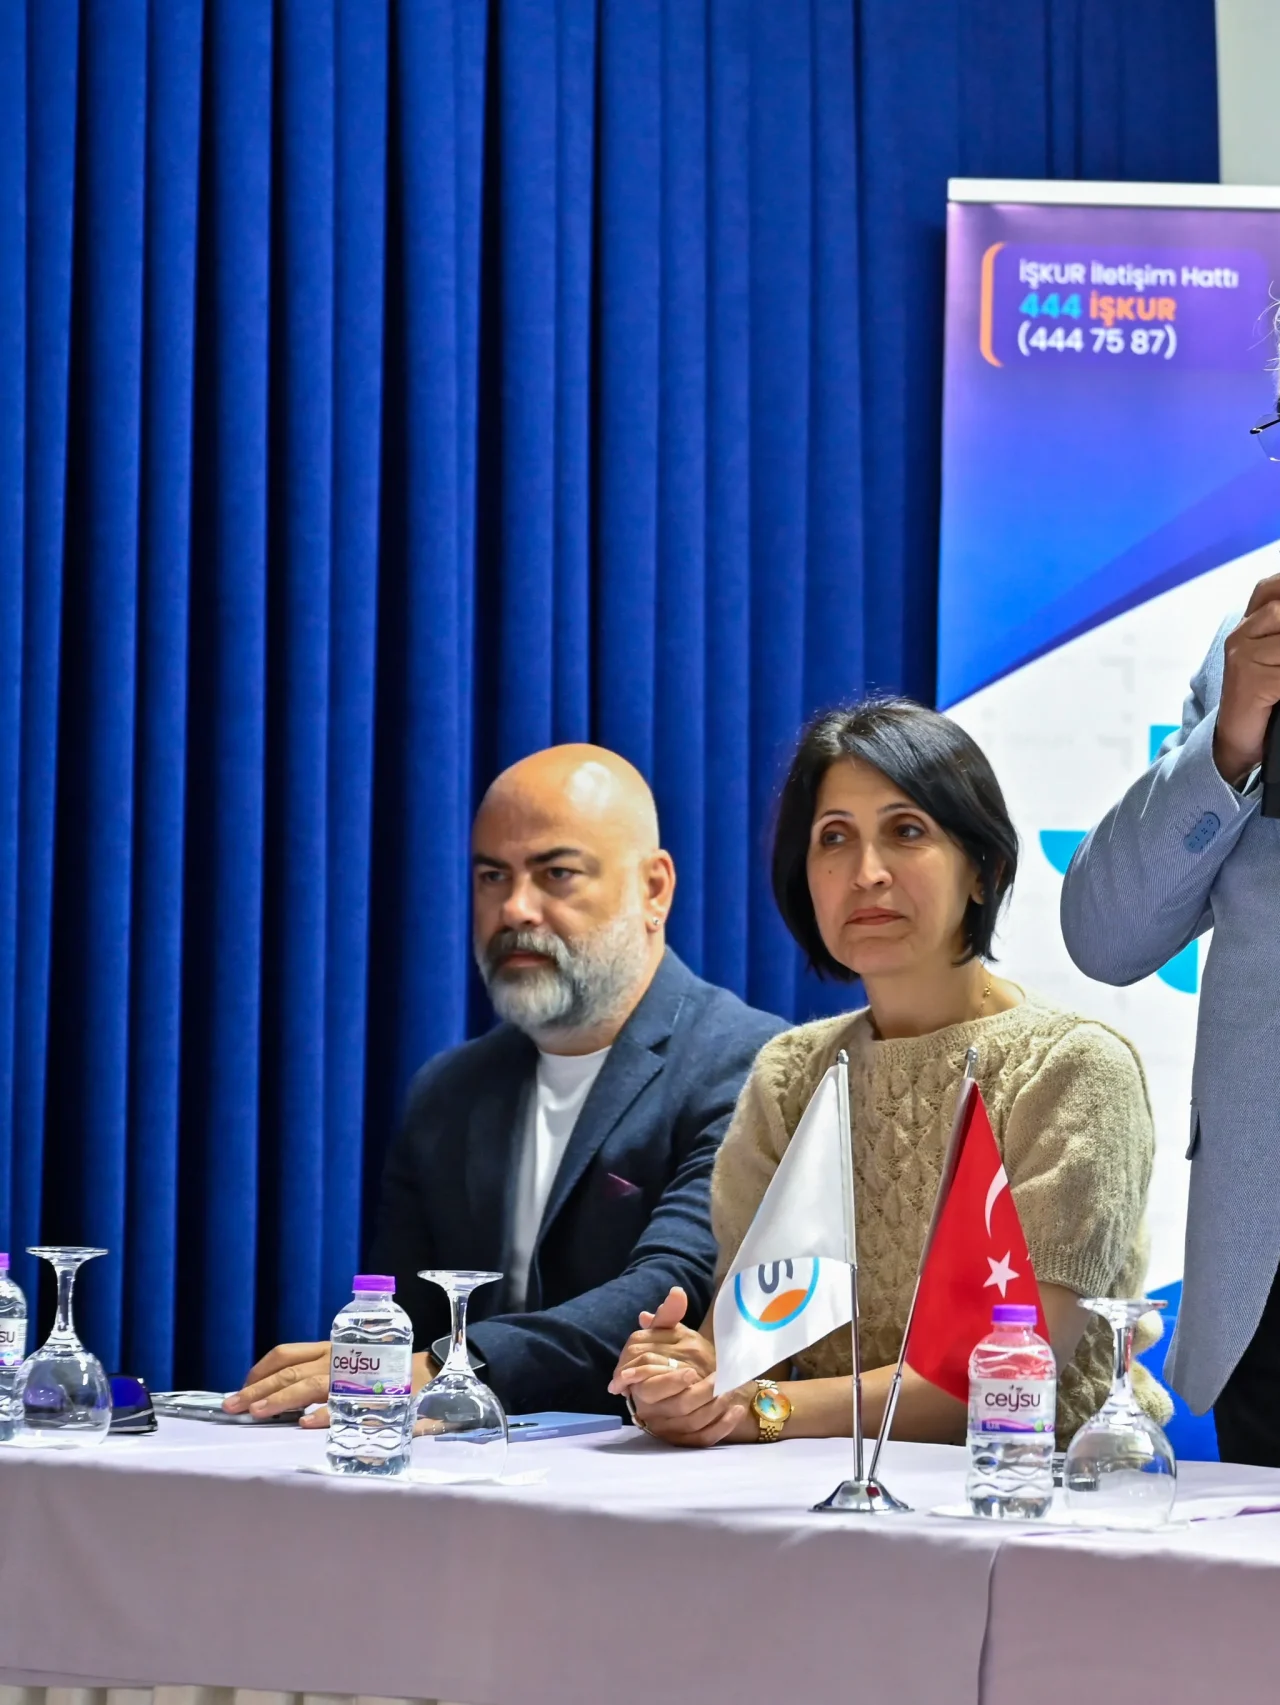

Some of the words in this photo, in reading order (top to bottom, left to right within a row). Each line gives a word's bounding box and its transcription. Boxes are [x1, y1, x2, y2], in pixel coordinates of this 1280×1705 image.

[1019, 258, 1086, 289] İŞKUR
[1090, 260, 1176, 291] İletişim
[1181, 266, 1239, 288] Hattı
[1019, 292, 1082, 318] 444
[1089, 290, 1177, 327] İŞKUR
[1017, 320, 1084, 357] (444
[1090, 327, 1125, 354] 75
[1130, 324, 1177, 360] 87)
[333, 1352, 380, 1375] ceysu
[985, 1388, 1041, 1412] ceysu
